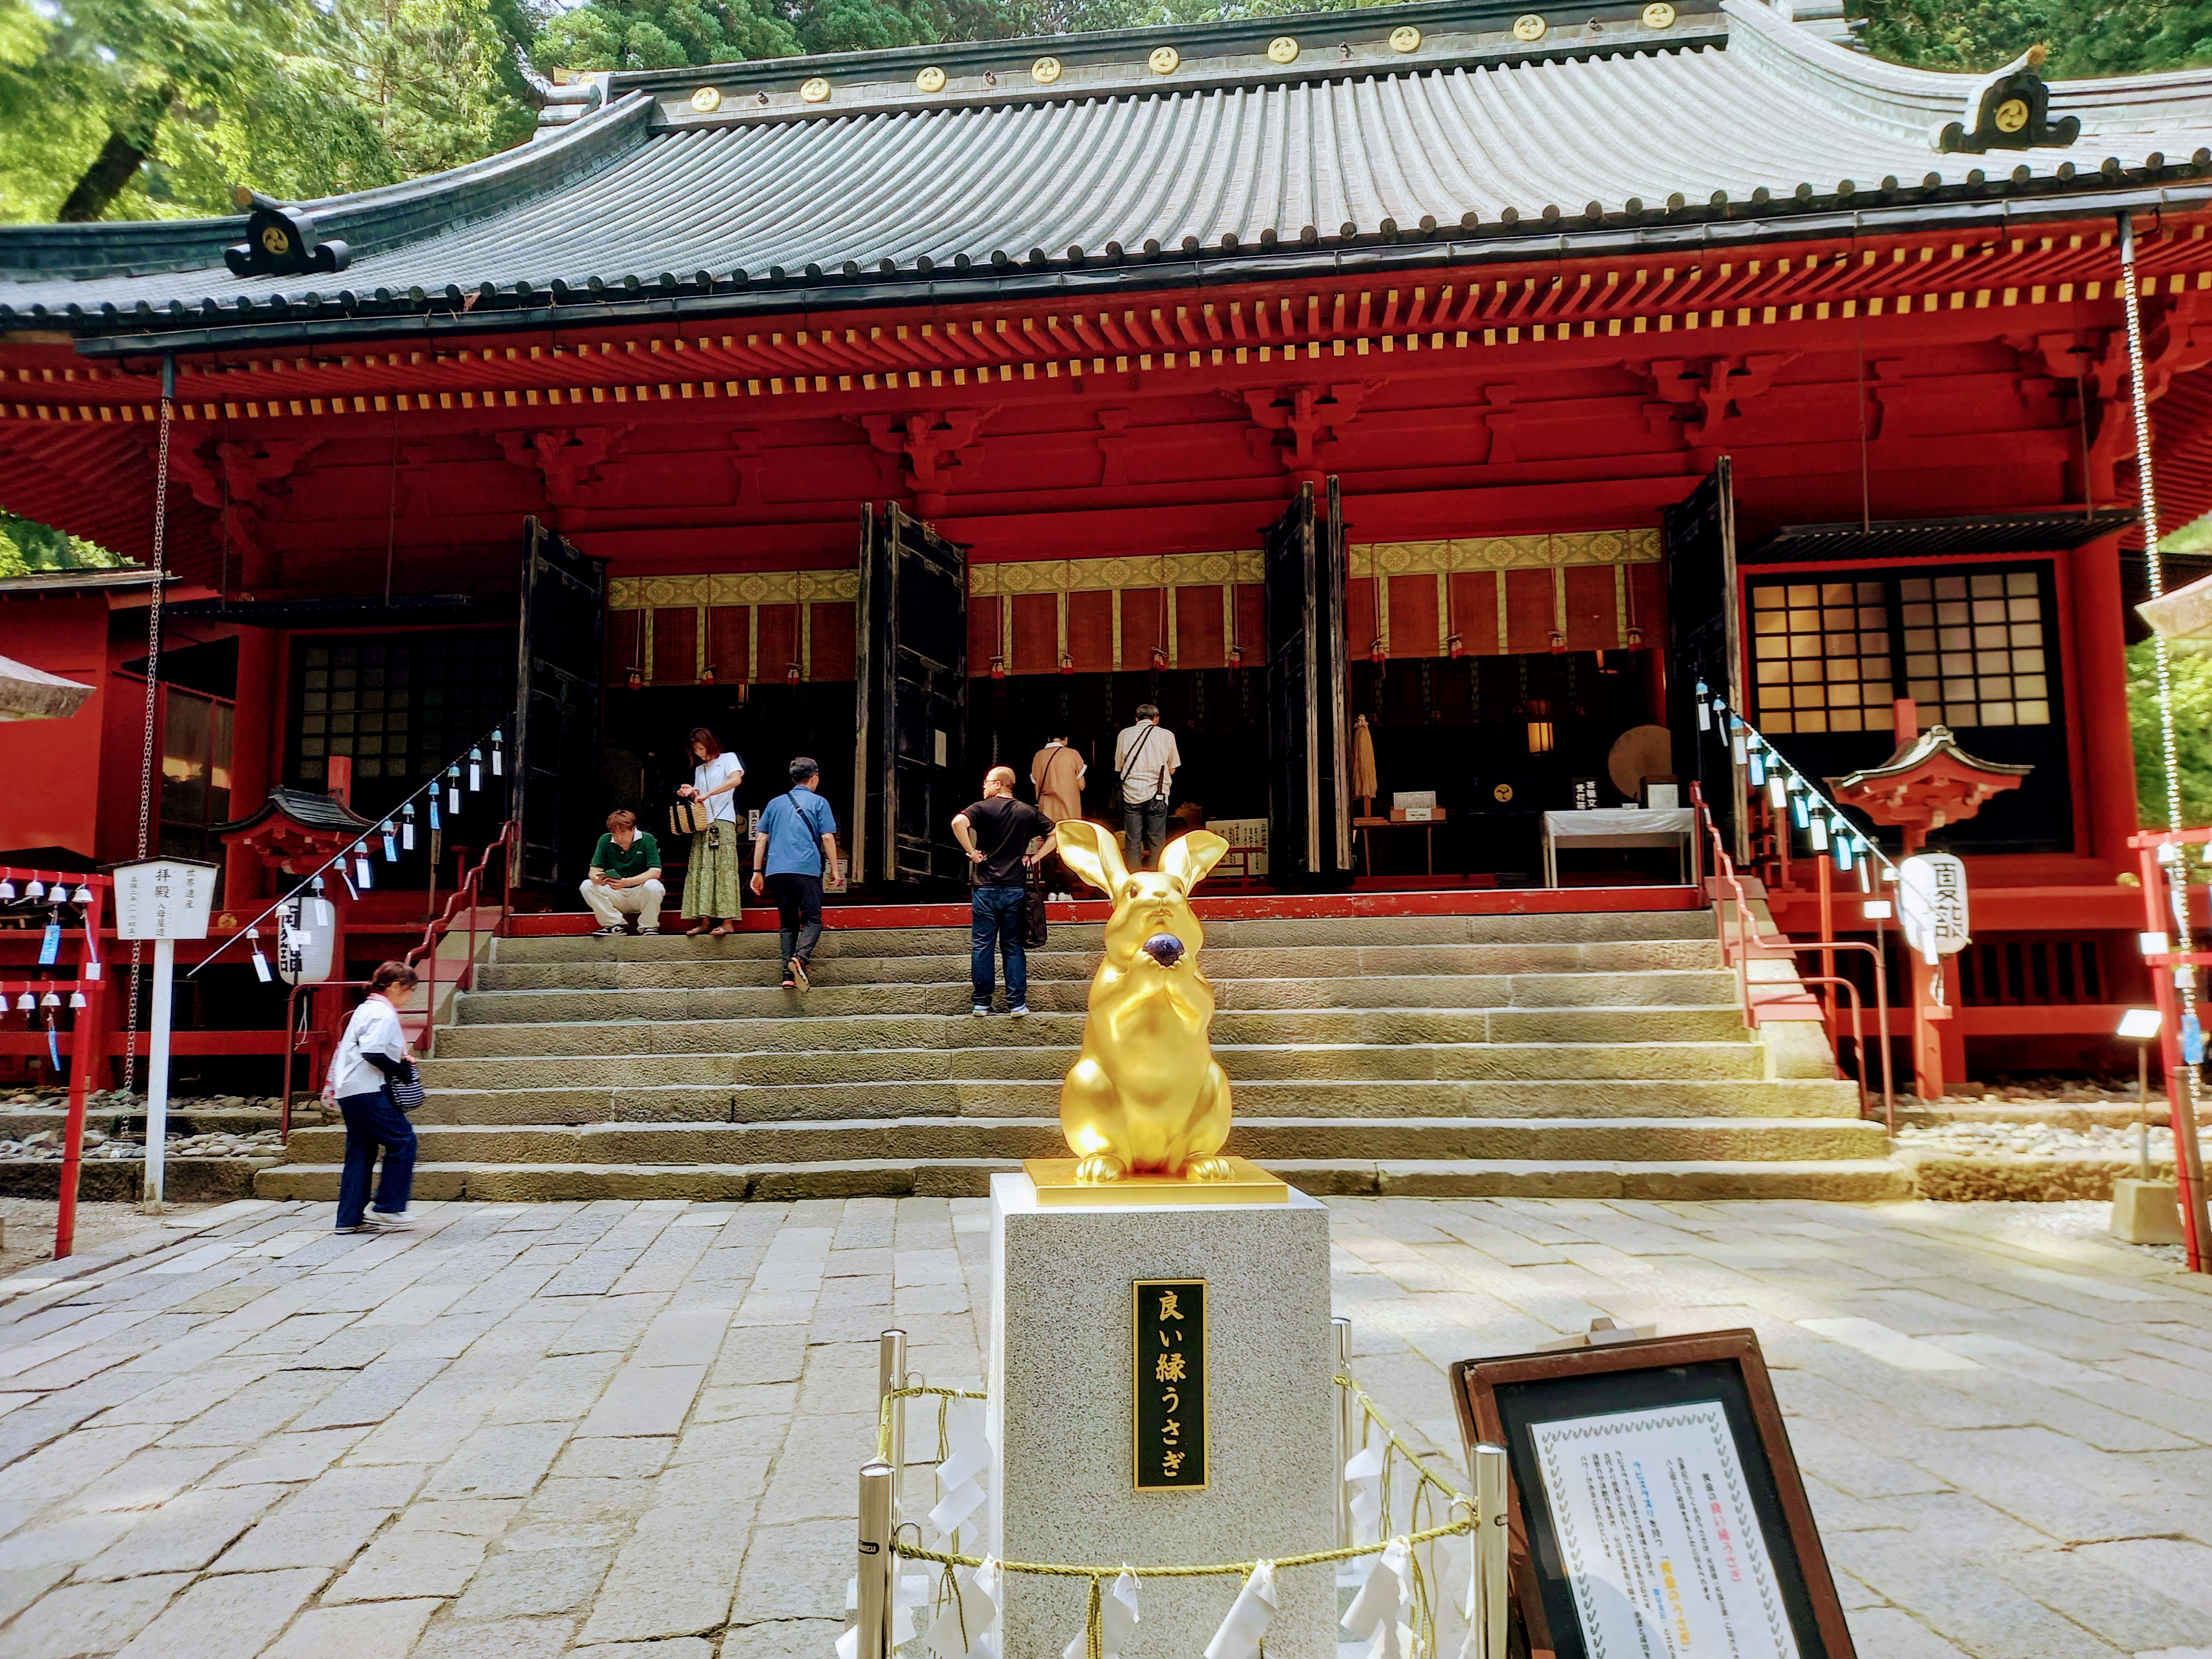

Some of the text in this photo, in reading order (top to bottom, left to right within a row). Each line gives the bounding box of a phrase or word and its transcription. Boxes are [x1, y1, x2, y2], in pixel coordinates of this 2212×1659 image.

[155, 868, 171, 936] 拝殿 入母屋造
[185, 868, 196, 909] 世界遺産
[1155, 1290, 1186, 1477] 良い縁うさぎ
